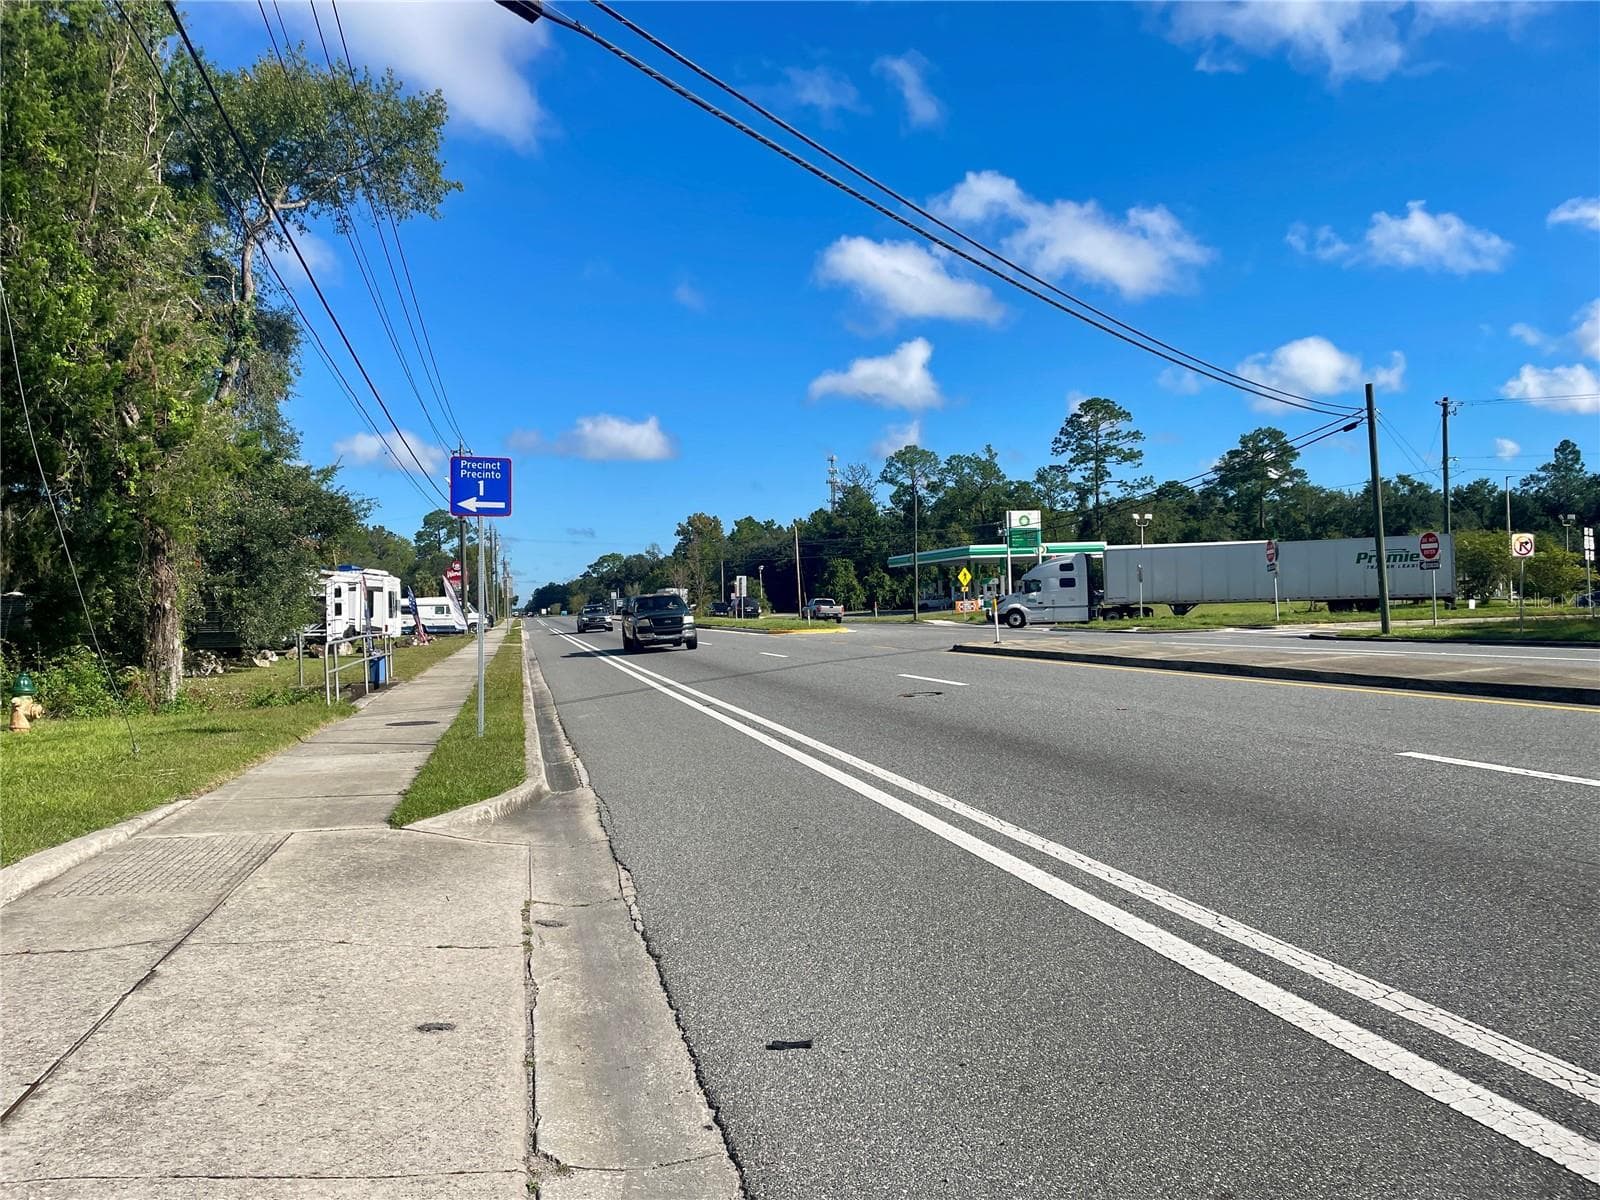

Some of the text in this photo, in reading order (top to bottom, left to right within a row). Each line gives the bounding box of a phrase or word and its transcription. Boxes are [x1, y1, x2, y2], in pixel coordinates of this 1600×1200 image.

[461, 460, 500, 470] Precinct
[460, 470, 501, 478] Precinto
[478, 480, 484, 496] 1
[1356, 552, 1420, 564] Prmie
